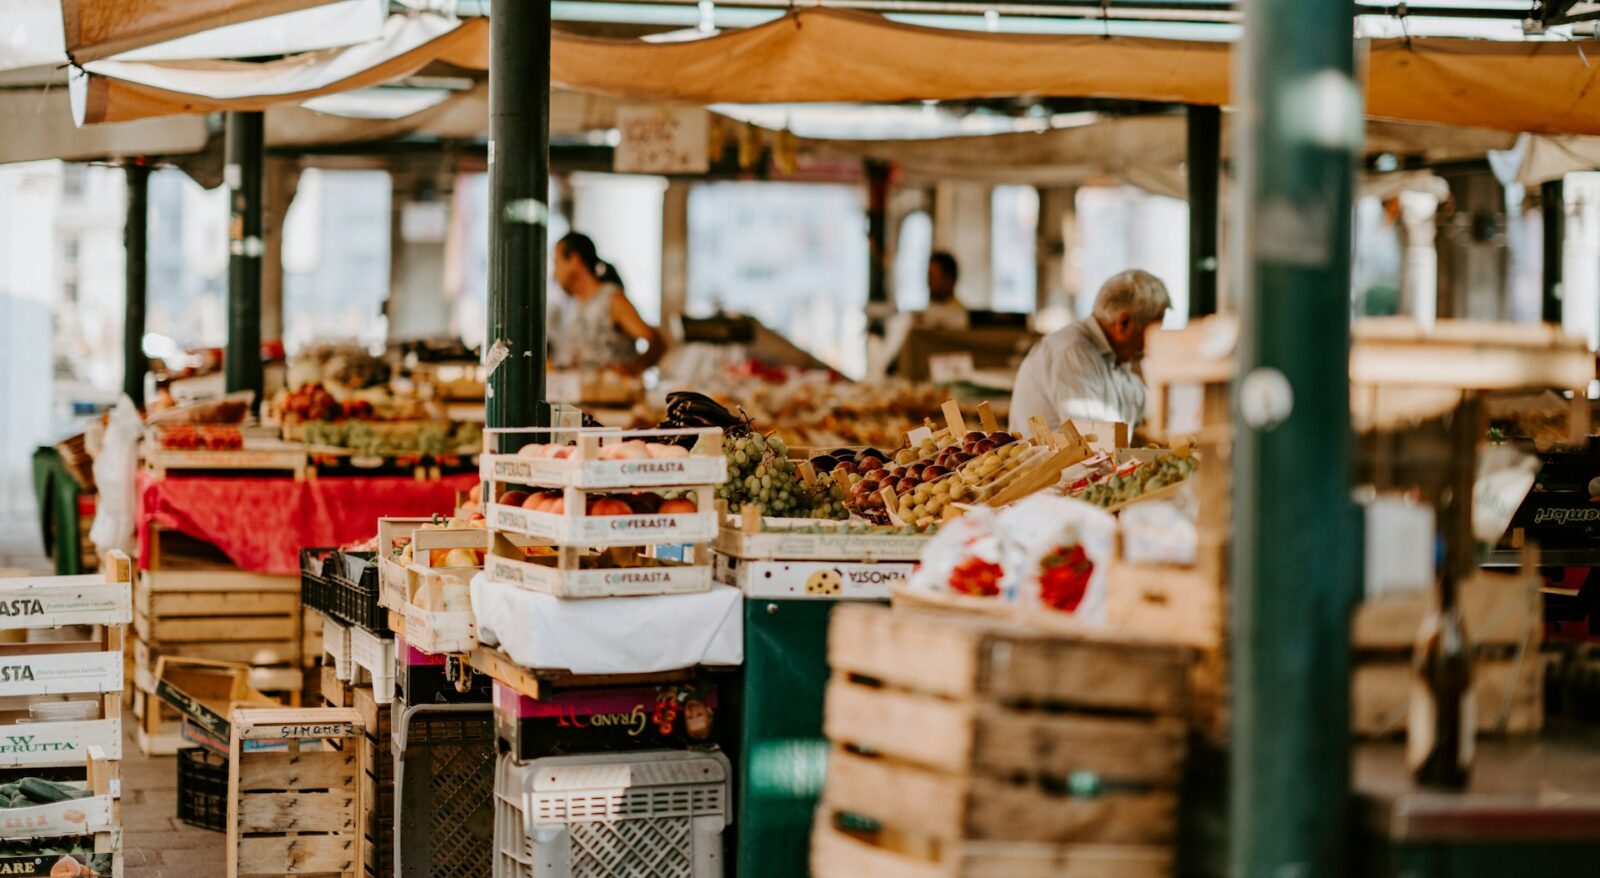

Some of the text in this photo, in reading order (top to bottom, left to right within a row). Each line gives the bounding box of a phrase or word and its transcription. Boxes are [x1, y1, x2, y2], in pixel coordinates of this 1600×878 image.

[620, 463, 685, 474] COFERASTA
[1534, 508, 1600, 524] embri
[610, 519, 677, 530] COFERASTA
[604, 573, 671, 584] COFERASTA
[0, 599, 44, 617] ASTA
[591, 703, 646, 737] GRAND
[0, 861, 35, 874] ARE
